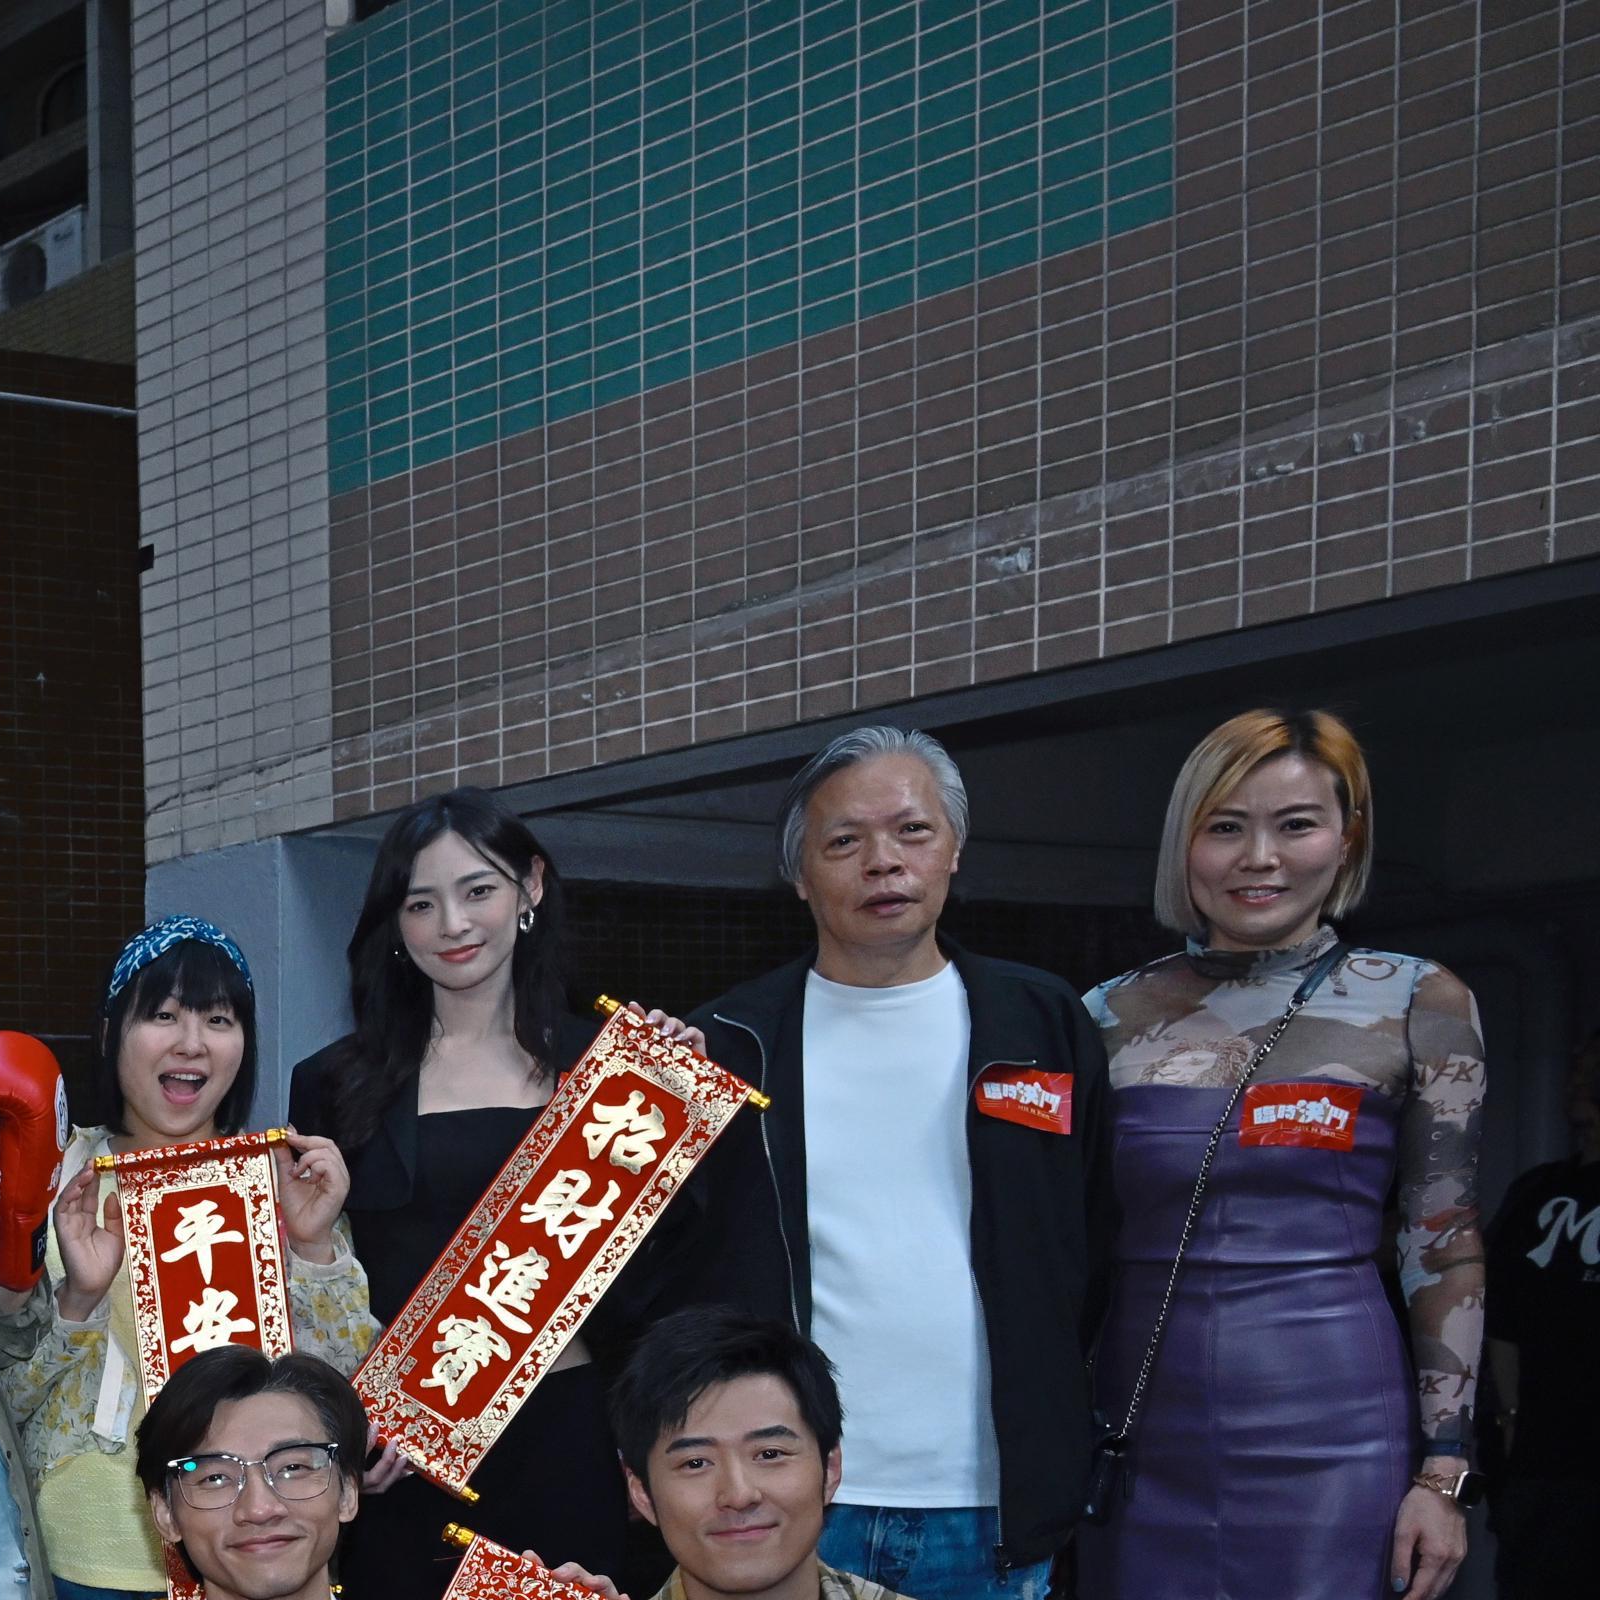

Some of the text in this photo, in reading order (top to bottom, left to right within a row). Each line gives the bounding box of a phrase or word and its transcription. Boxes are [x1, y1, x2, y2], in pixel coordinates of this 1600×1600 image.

[160, 1199, 257, 1354] 平安
[418, 1089, 667, 1406] 招財進寶
